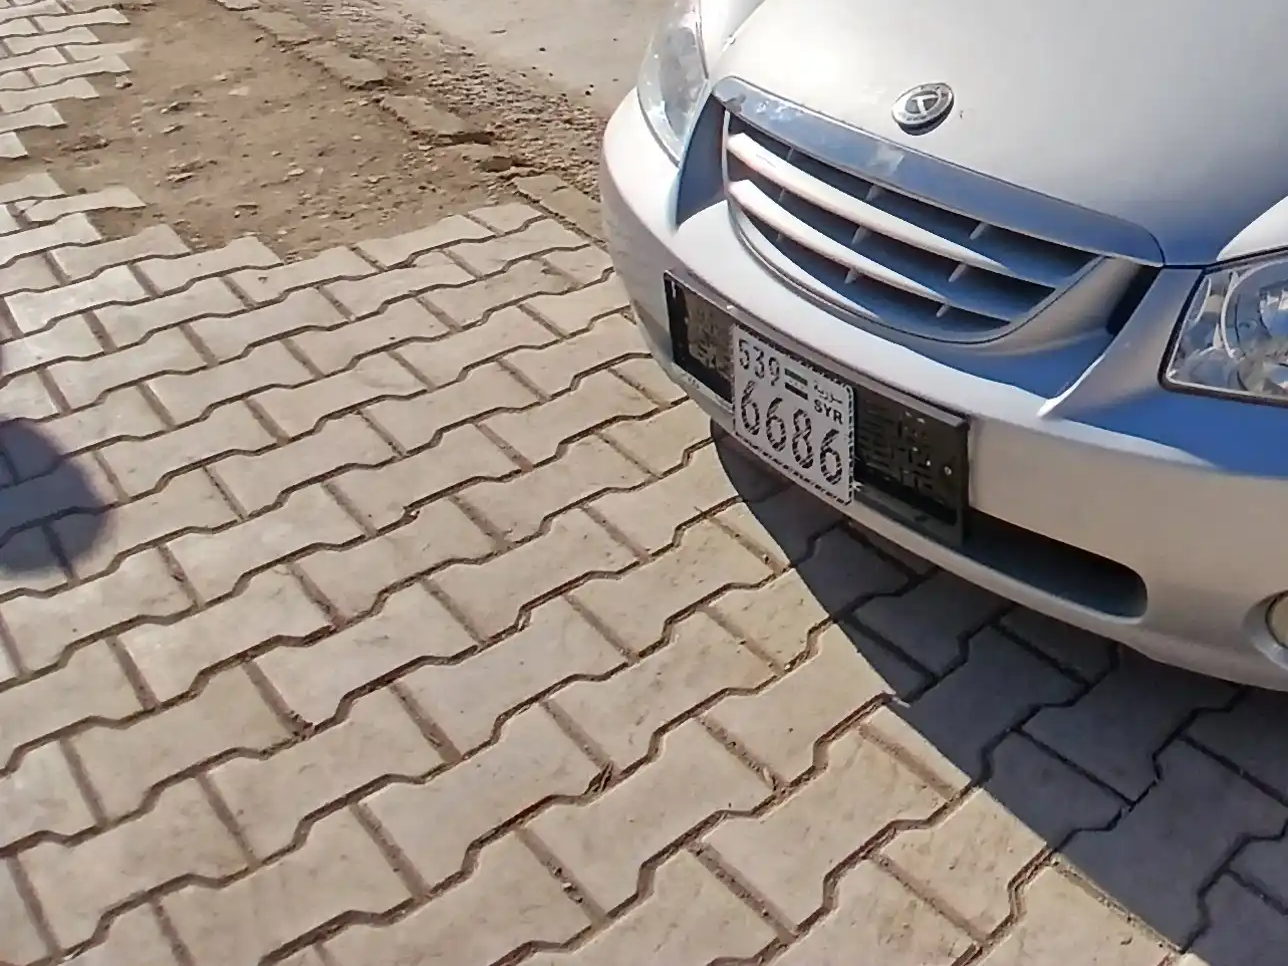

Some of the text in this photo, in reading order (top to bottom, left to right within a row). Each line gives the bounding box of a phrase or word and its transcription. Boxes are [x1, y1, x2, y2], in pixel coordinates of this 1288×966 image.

[739, 338, 781, 387] 539
[740, 380, 844, 486] 6686
[813, 399, 844, 426] SYR
